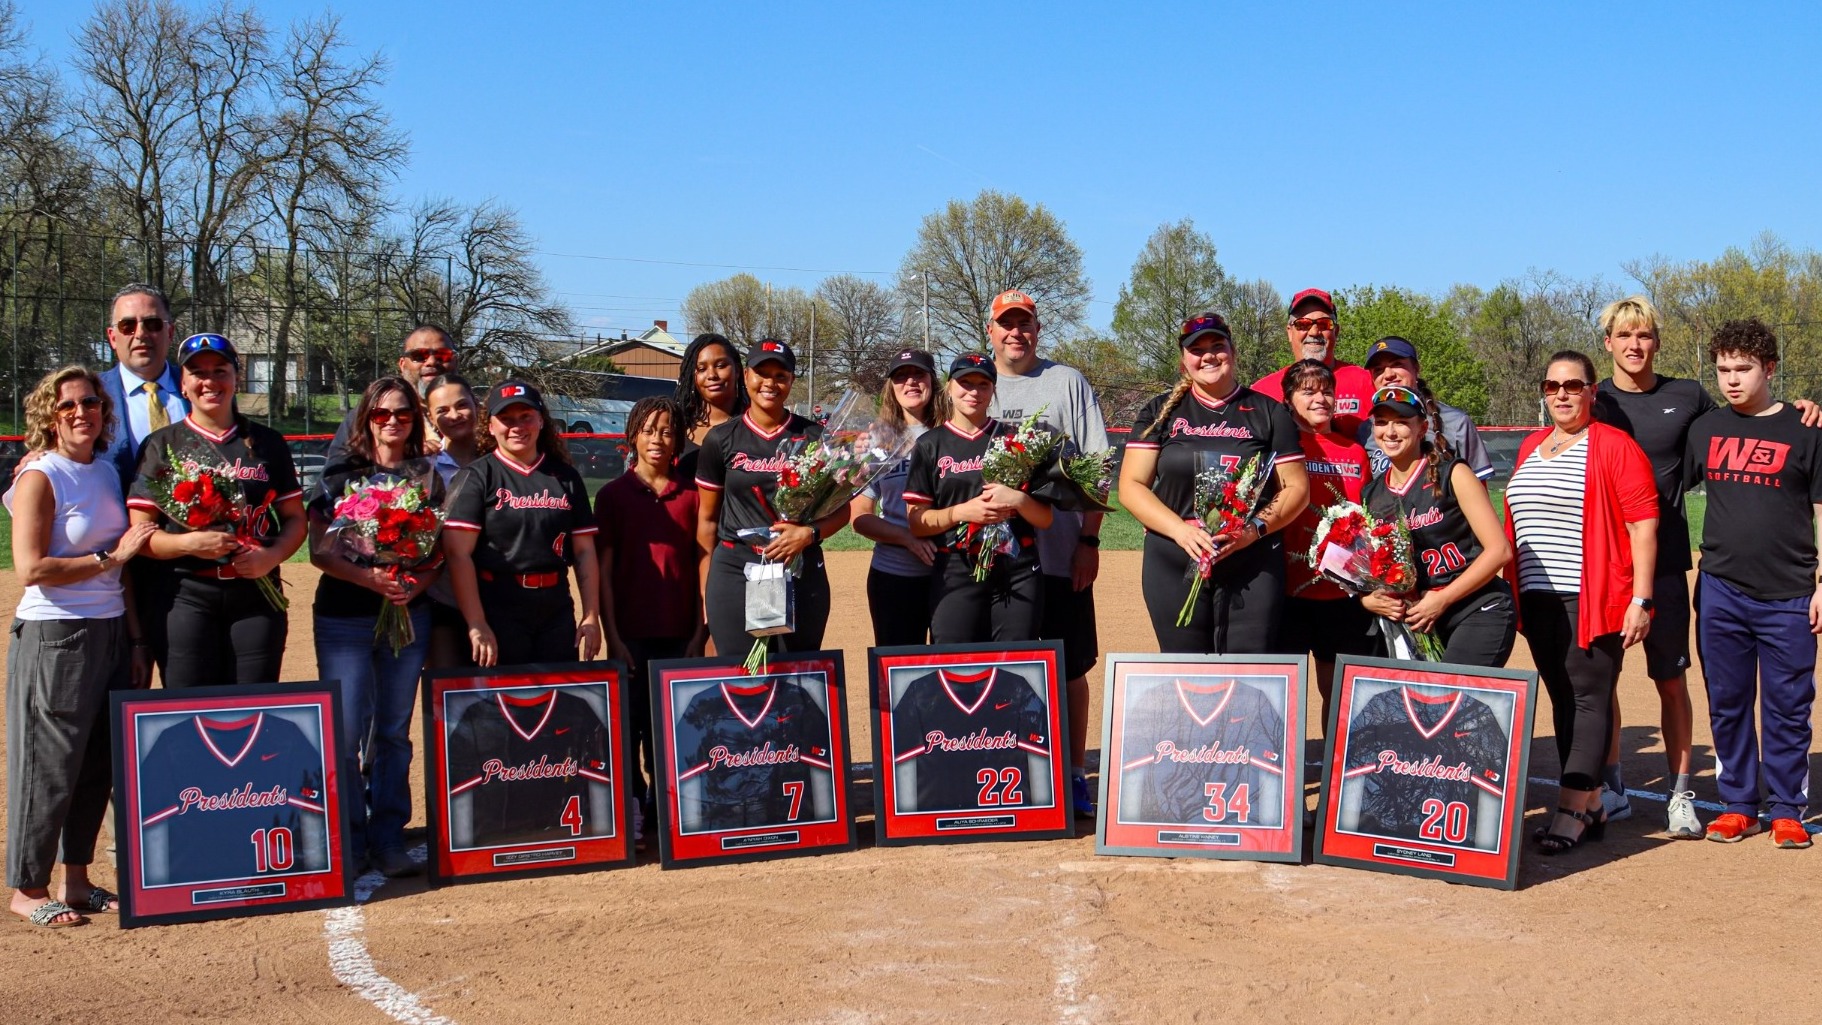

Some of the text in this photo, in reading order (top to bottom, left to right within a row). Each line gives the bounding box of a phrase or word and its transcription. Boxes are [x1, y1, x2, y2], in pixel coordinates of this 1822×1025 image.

[1169, 417, 1253, 438] Presidents
[1707, 436, 1791, 474] W&J
[1707, 472, 1781, 487] SOFTBALL
[1421, 541, 1466, 577] 20
[709, 741, 800, 771] Presidents
[925, 727, 1018, 754] Presidents
[1154, 740, 1249, 764] Presidents
[482, 754, 578, 785] Presidents
[1375, 750, 1471, 782] Presidents
[179, 782, 287, 815] Presidents
[783, 781, 804, 821] 7
[977, 767, 1023, 806] 22
[1203, 782, 1250, 823] 34
[560, 795, 582, 836] 4
[1419, 798, 1469, 843] 20
[251, 827, 294, 873] 10
